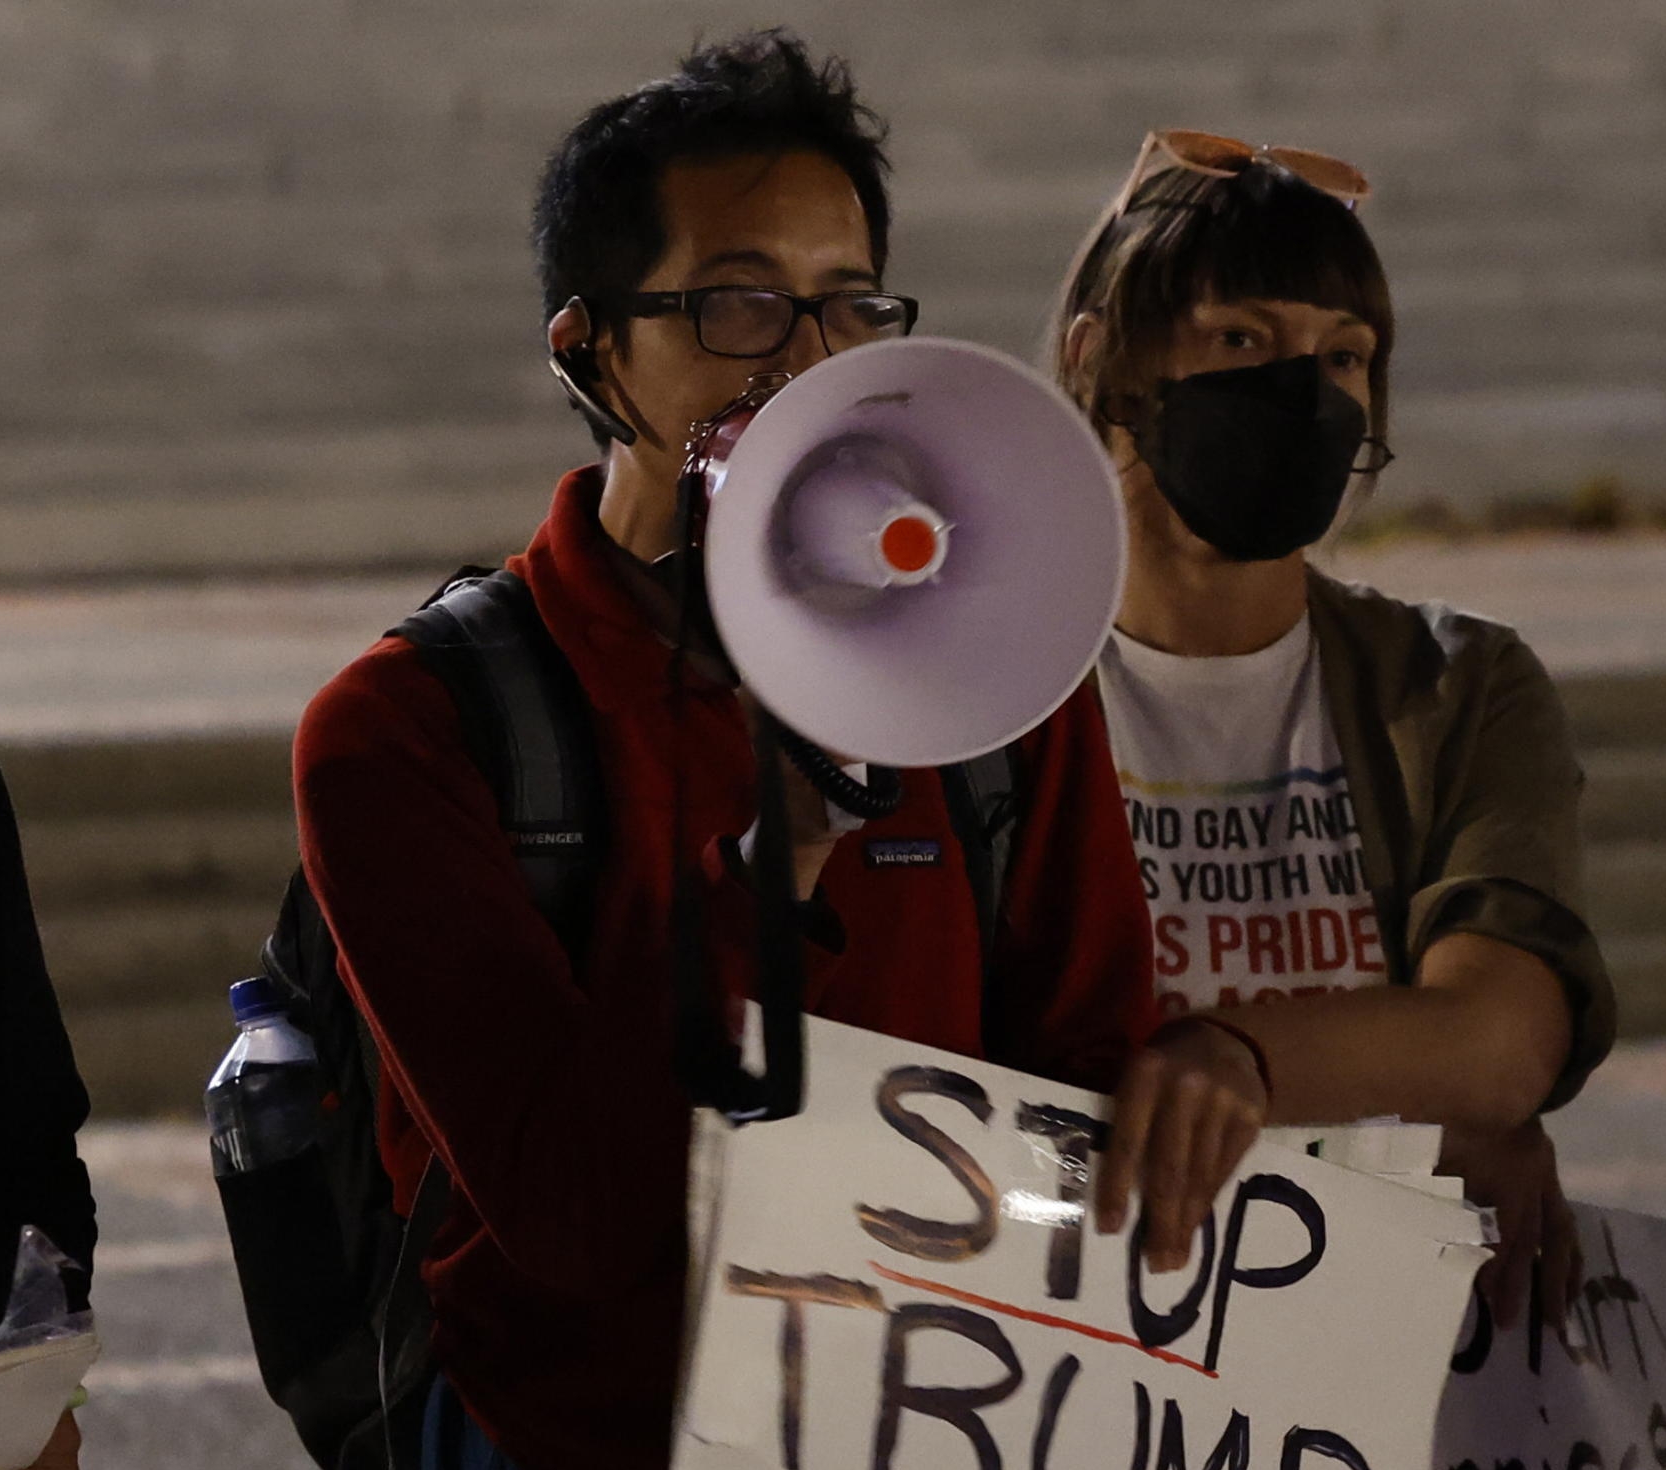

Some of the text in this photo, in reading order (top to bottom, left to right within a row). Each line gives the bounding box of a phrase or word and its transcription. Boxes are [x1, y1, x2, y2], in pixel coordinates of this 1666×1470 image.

[519, 831, 585, 845] WENGER
[1195, 803, 1274, 850] GAY
[875, 852, 935, 865] patagonia
[1172, 853, 1309, 903] YOUTH
[1208, 907, 1386, 974] PRIDE
[855, 1065, 1327, 1372] STOP
